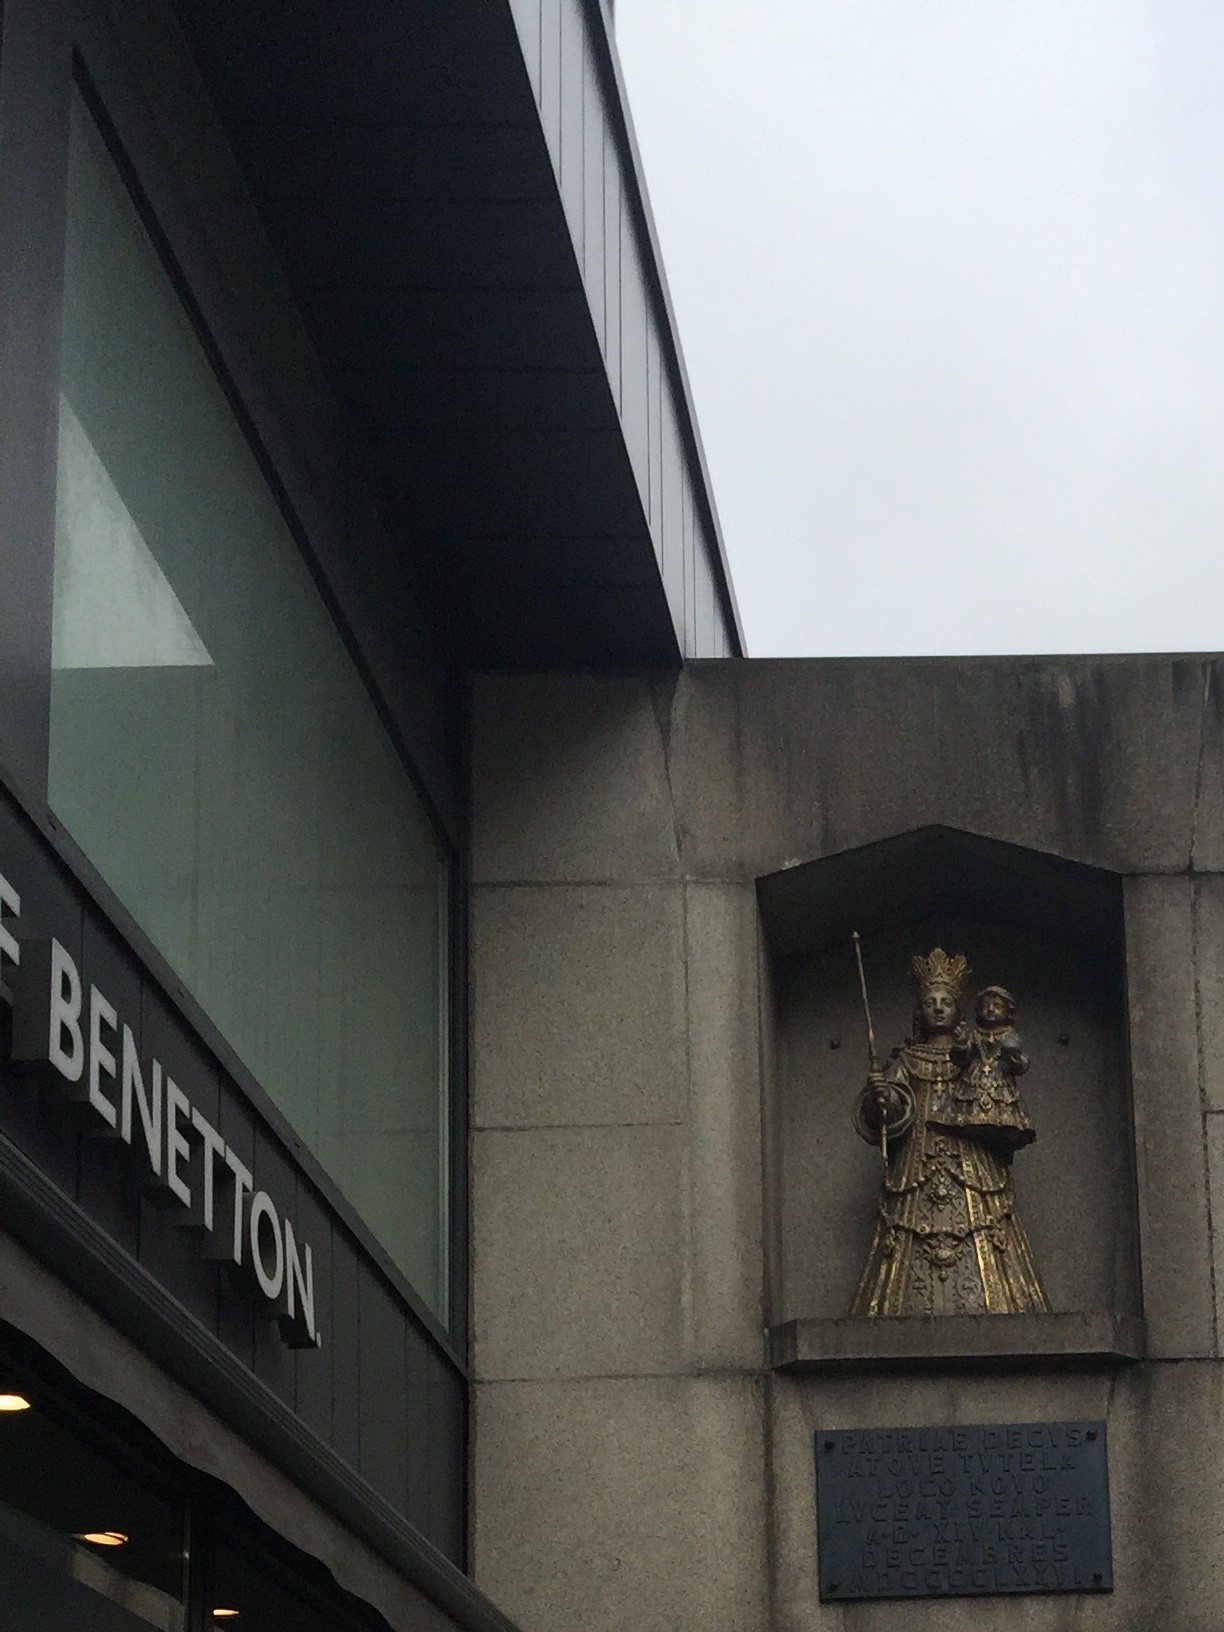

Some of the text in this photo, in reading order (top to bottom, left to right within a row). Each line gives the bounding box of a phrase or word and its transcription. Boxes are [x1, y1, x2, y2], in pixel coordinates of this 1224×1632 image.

[841, 1427, 1083, 1455] PATRIAE DECVS
[959, 1451, 1077, 1474] TVTELA
[876, 1475, 1050, 1500] LOCO NOVO
